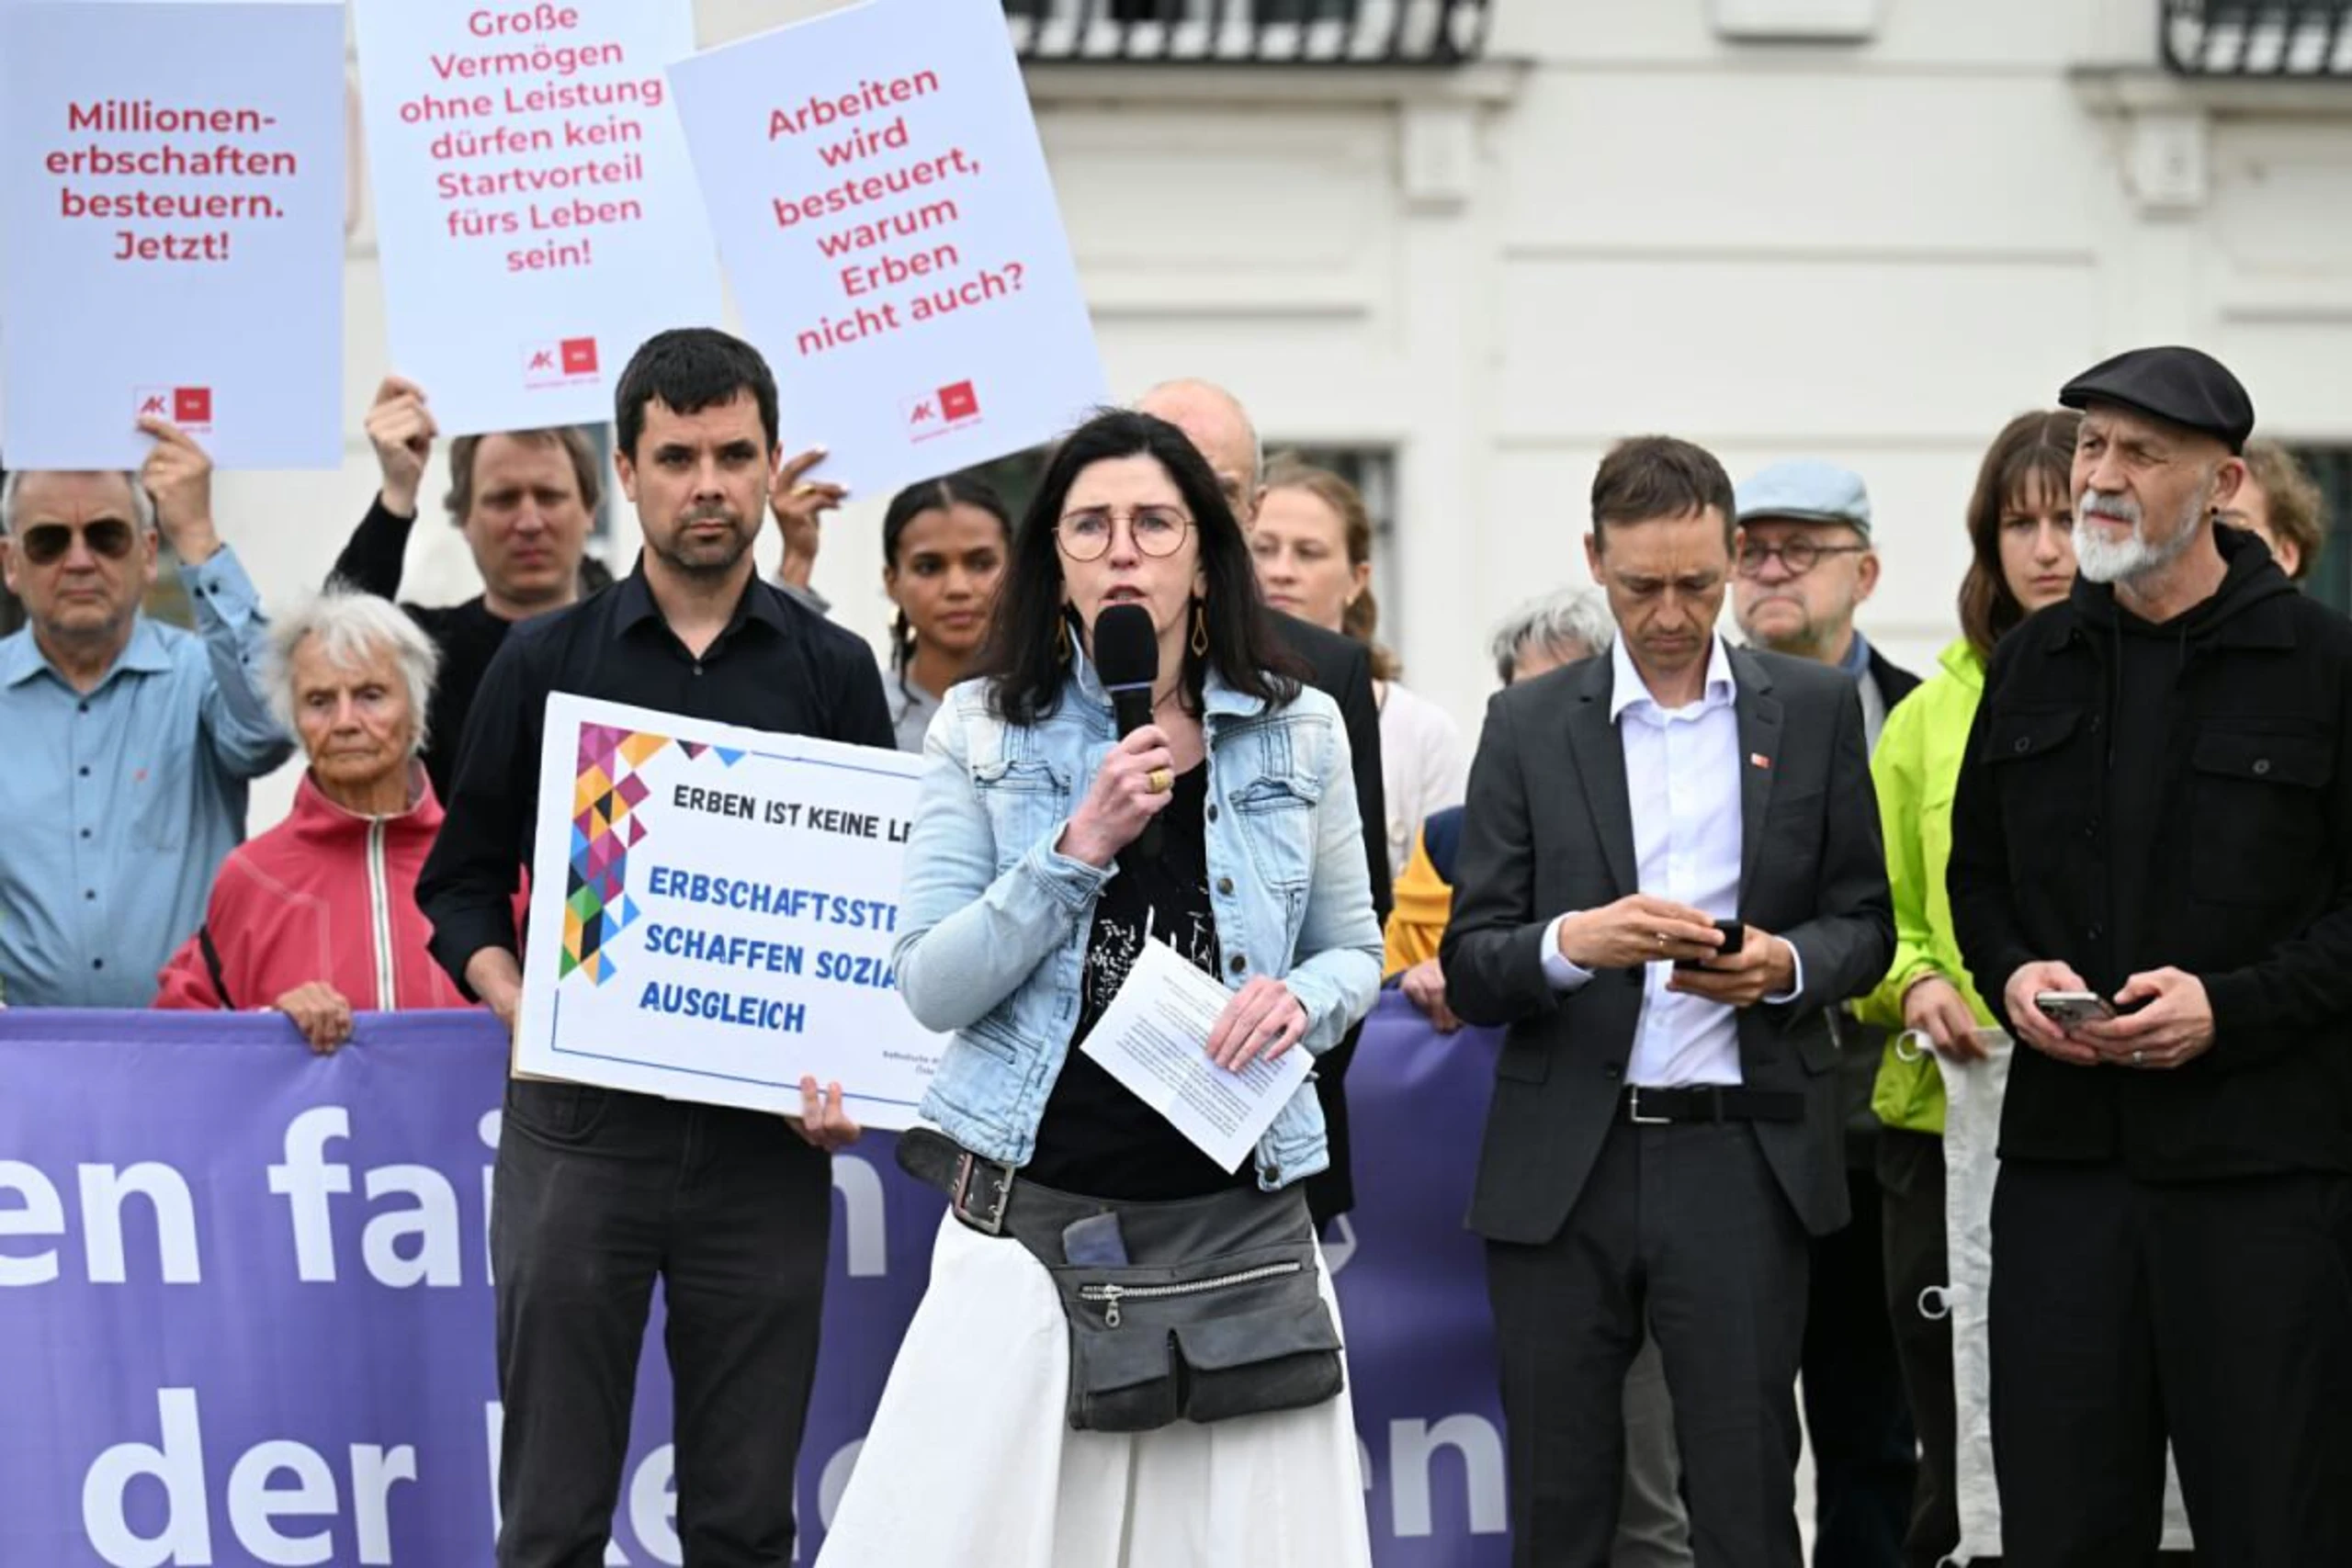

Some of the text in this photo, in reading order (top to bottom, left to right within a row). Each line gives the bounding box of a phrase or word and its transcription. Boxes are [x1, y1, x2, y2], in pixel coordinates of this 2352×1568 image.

[469, 4, 577, 37] Große
[431, 43, 623, 80] Vermögen
[68, 99, 276, 132] Millionen-
[401, 79, 662, 124] ohne Leistung
[770, 71, 938, 139] Arbeiten
[46, 144, 296, 175] erbschaften
[431, 116, 642, 160] dürfen kein
[820, 118, 908, 166] wird
[438, 153, 642, 198] Startvorteil
[774, 149, 979, 228] besteuert,
[62, 187, 283, 218] besteuern.
[447, 199, 641, 237] fürs Leben
[114, 231, 229, 261] Jetzt!
[818, 200, 957, 258] warum
[507, 239, 591, 272] sein!
[841, 245, 957, 297] Erben
[798, 263, 1023, 355] nicht auch?
[674, 784, 755, 819] ERBEN
[764, 800, 801, 826] IST
[808, 807, 879, 838] KEINE
[644, 924, 804, 974] SCHAFFEN
[640, 982, 805, 1033] AUSGLEICH
[83, 1388, 417, 1566] der
